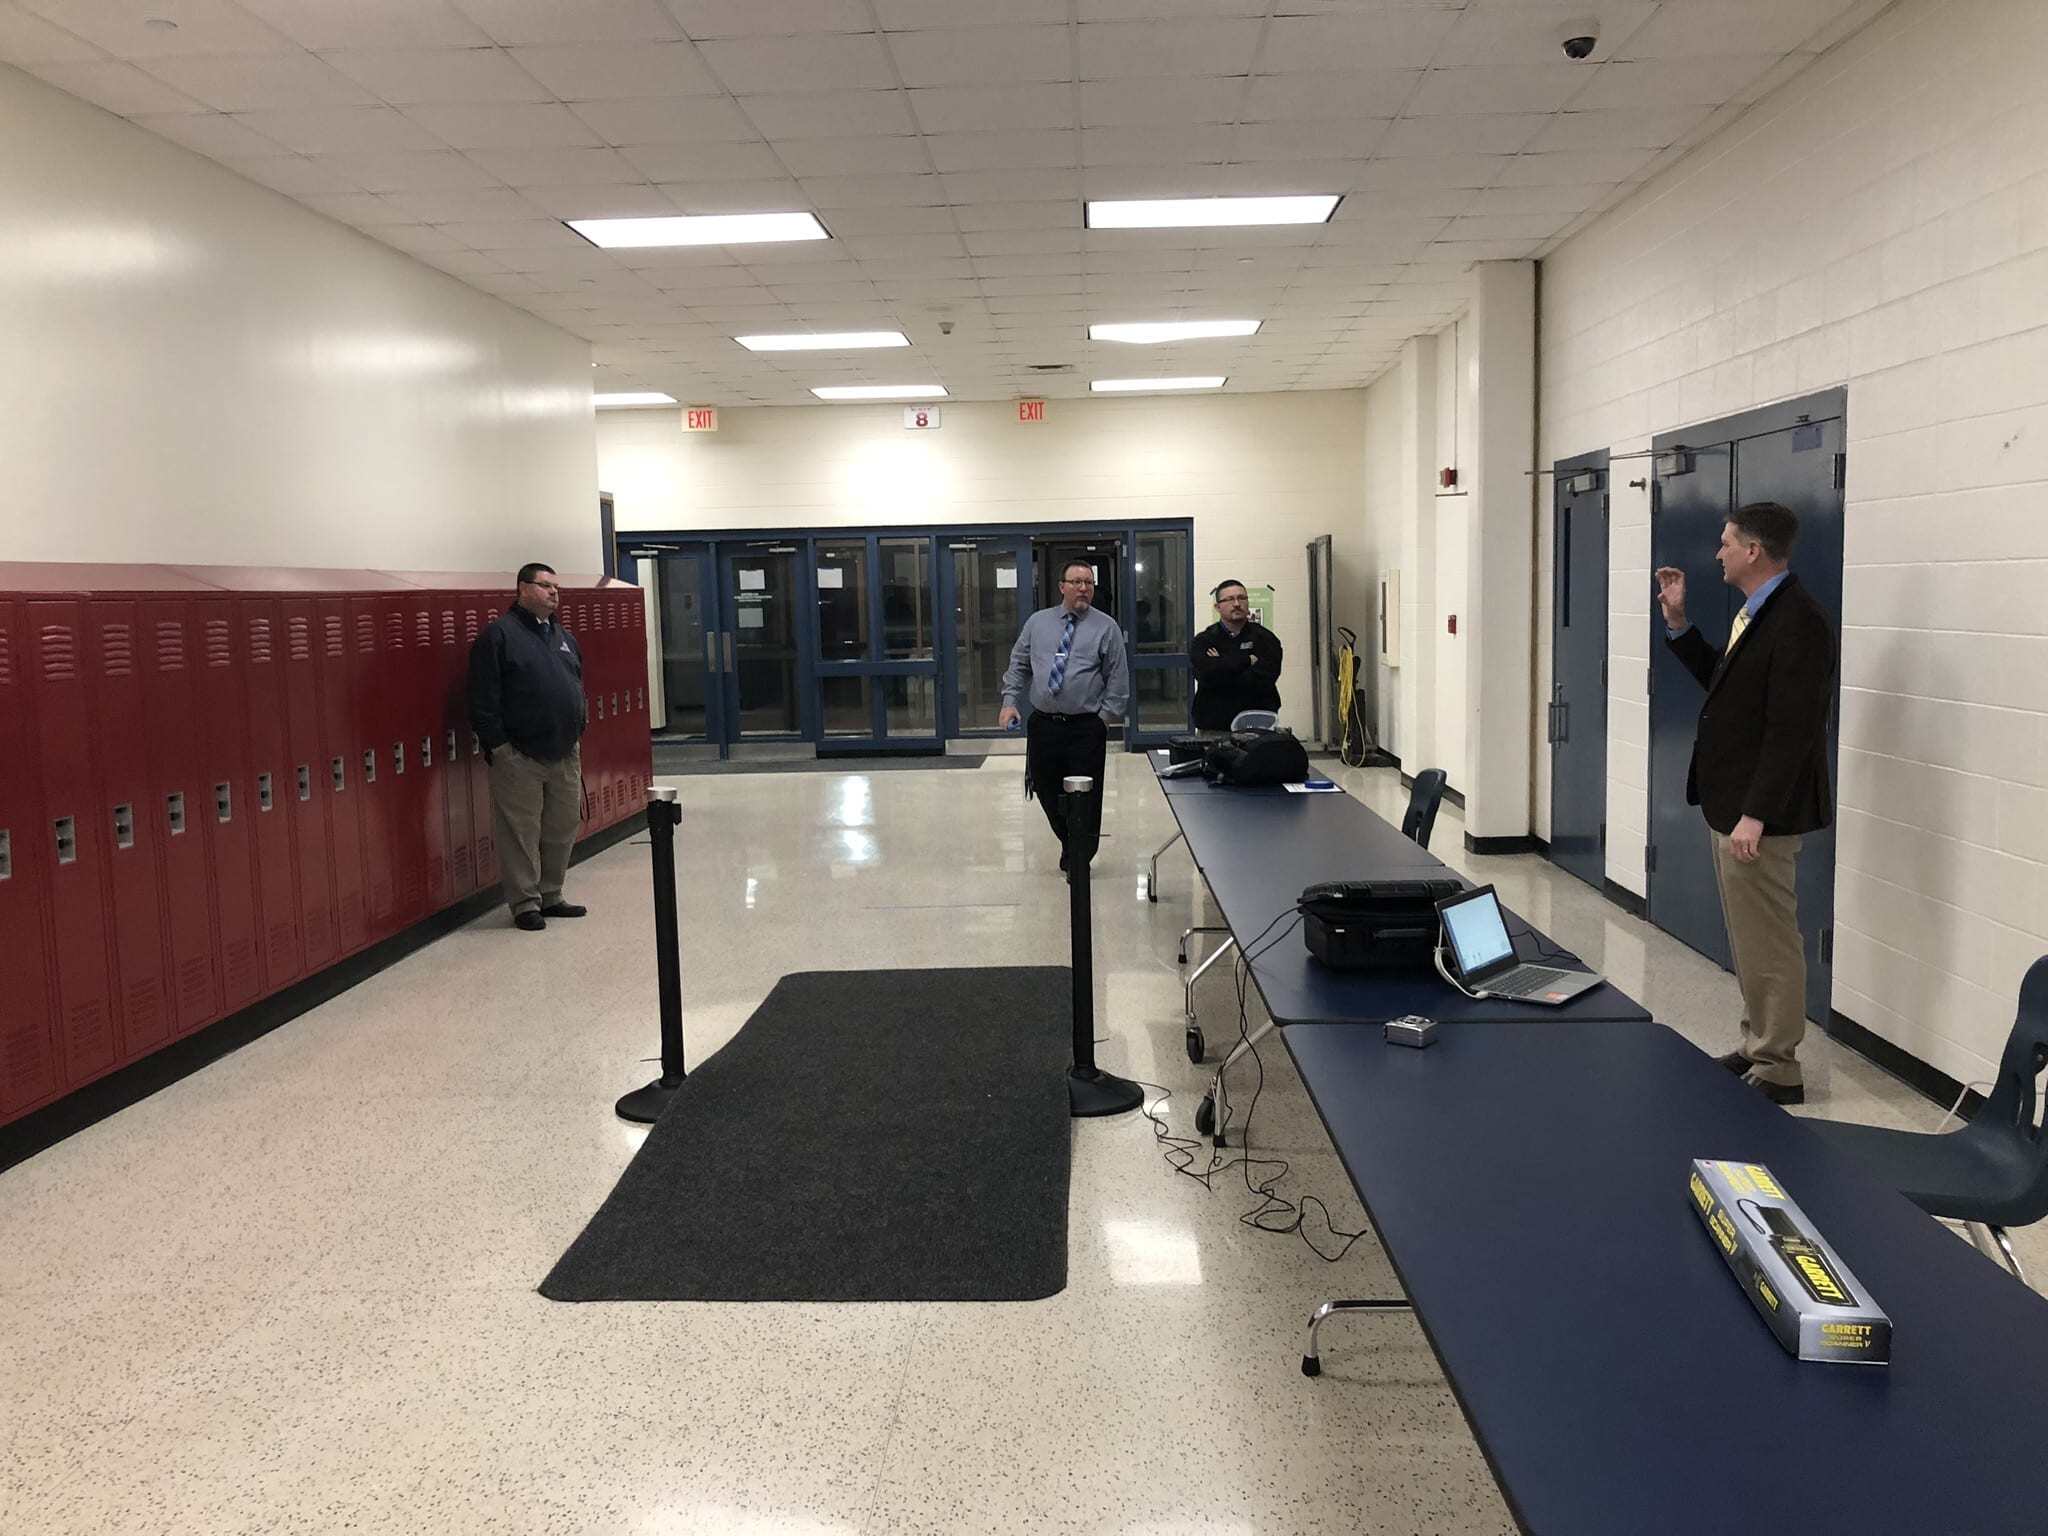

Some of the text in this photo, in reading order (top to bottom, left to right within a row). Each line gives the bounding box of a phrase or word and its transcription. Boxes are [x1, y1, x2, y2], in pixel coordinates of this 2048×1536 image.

[688, 409, 713, 429] EXIT
[915, 412, 929, 428] 8
[1019, 401, 1044, 421] EXIT
[1795, 1255, 1845, 1300] GARRETT
[1823, 1323, 1873, 1336] GARRETT
